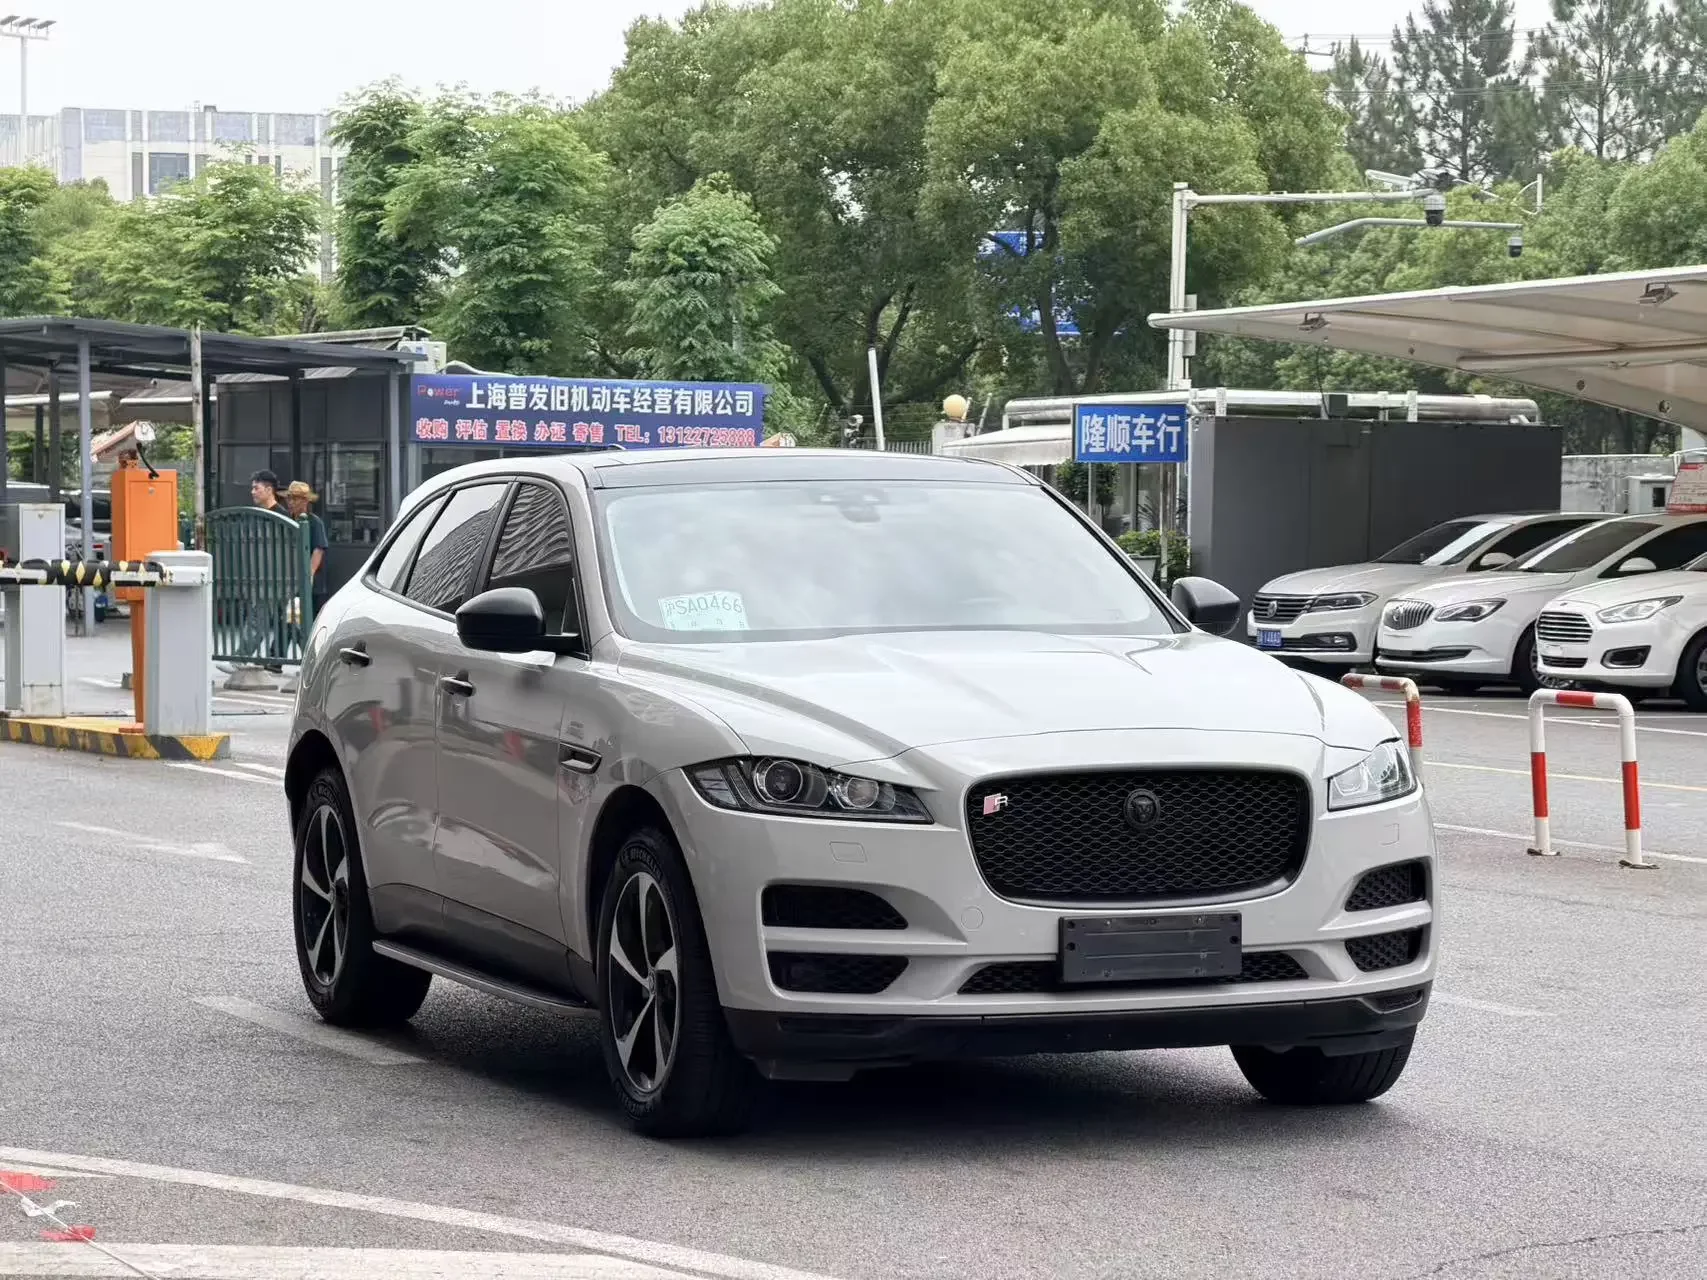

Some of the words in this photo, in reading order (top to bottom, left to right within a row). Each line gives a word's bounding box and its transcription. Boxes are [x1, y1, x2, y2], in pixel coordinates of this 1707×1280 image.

[417, 384, 462, 398] Power
[466, 381, 754, 417] 上海普发旧机动车经营有限公司
[416, 418, 449, 439] 收购
[456, 419, 488, 440] 评估
[495, 420, 527, 441] 置换
[534, 420, 567, 442] 办证
[573, 421, 604, 443] 寄售
[1081, 413, 1182, 454] 隆顺车行
